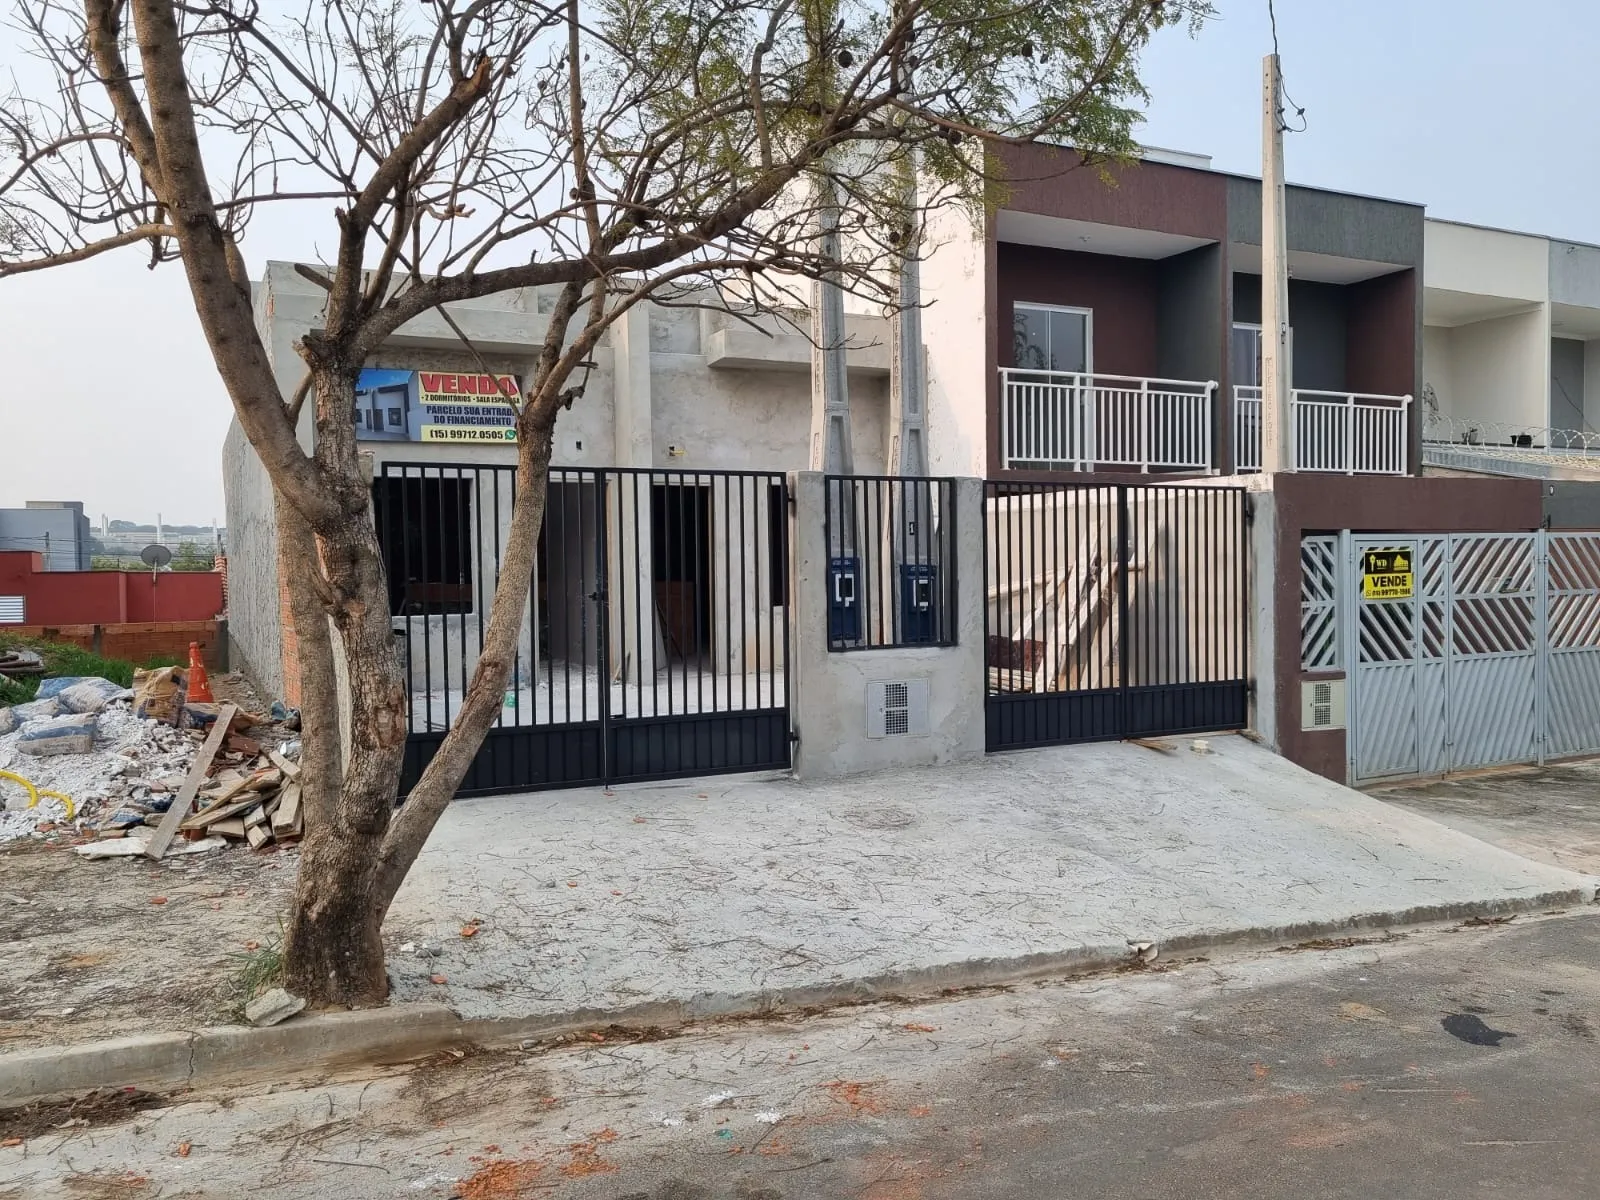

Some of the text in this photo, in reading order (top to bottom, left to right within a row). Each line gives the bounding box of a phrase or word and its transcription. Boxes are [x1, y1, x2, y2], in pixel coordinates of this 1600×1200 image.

[420, 373, 518, 395] VENDO
[426, 405, 462, 415] PARCELO
[464, 406, 480, 416] SUA
[434, 415, 512, 426] DO FINANCIAMENTO
[430, 429, 504, 439] (15) 99712.0505
[1372, 575, 1407, 587] VENDE
